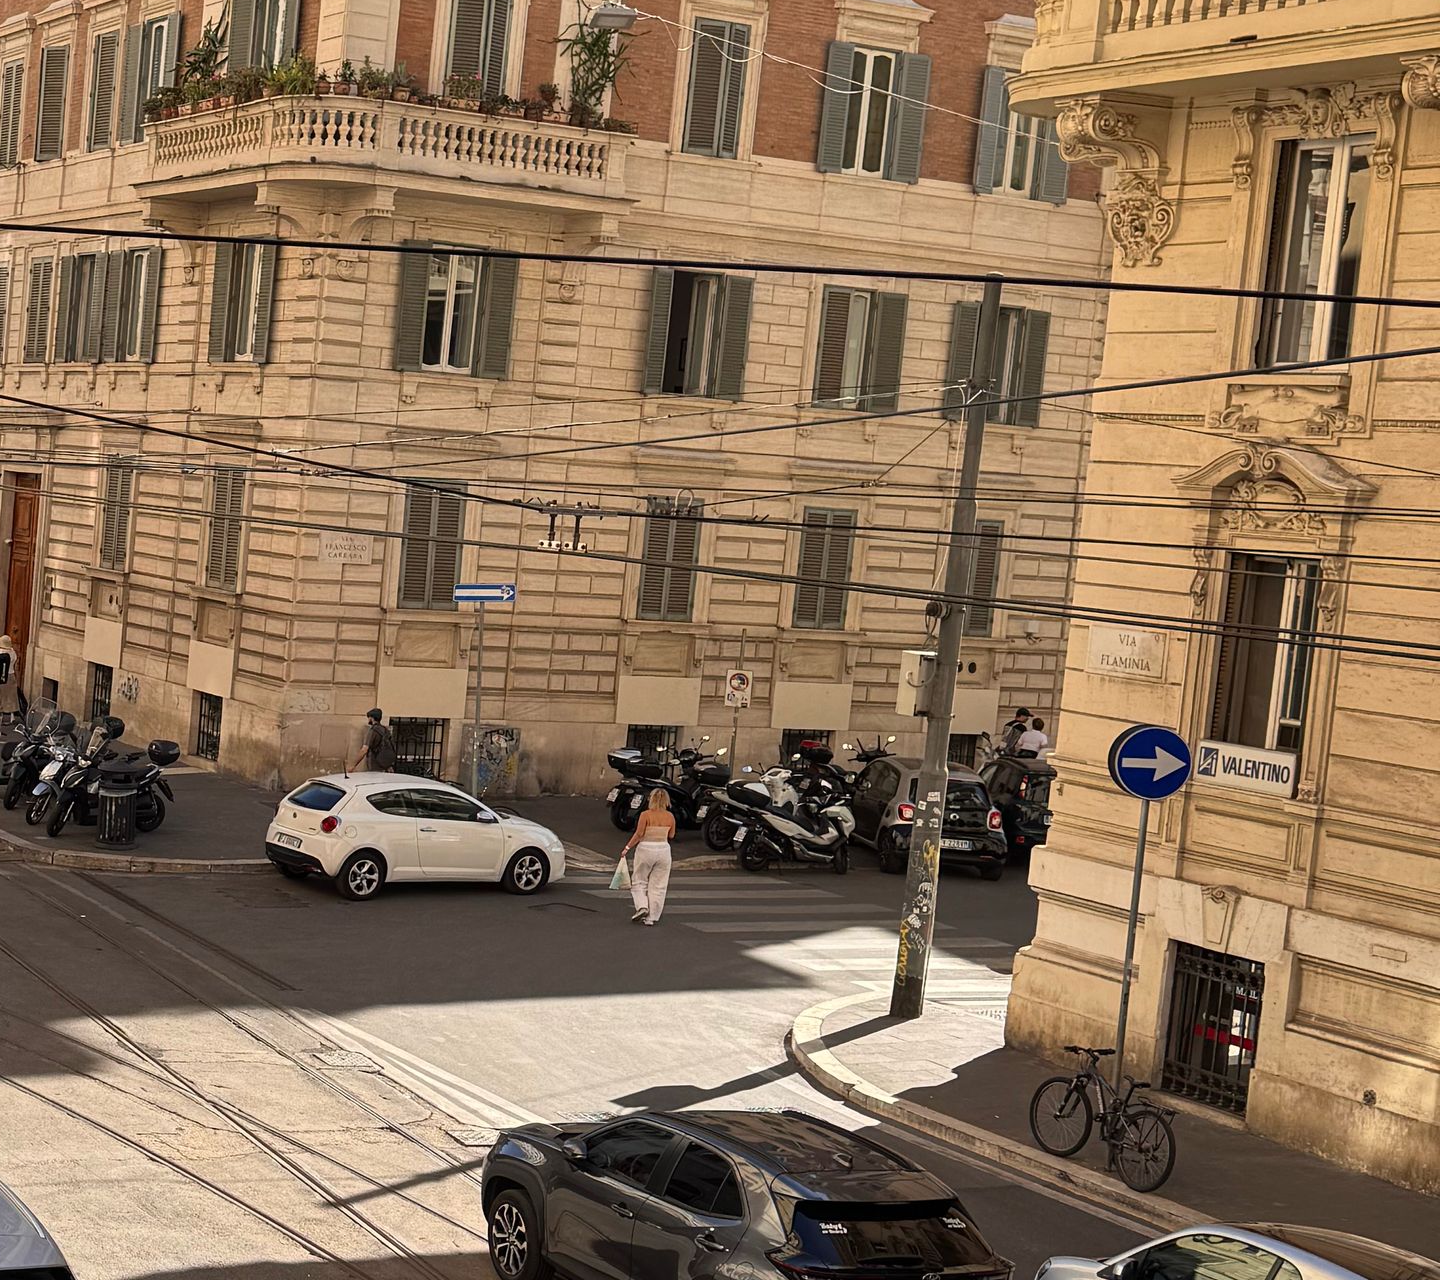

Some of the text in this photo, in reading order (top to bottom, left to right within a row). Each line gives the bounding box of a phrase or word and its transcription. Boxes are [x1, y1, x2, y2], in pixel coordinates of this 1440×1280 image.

[325, 543, 368, 552] FRANCESCO
[1118, 634, 1137, 647] VIA
[1100, 654, 1151, 672] FLAMINIA
[1222, 755, 1291, 785] VALENTINO
